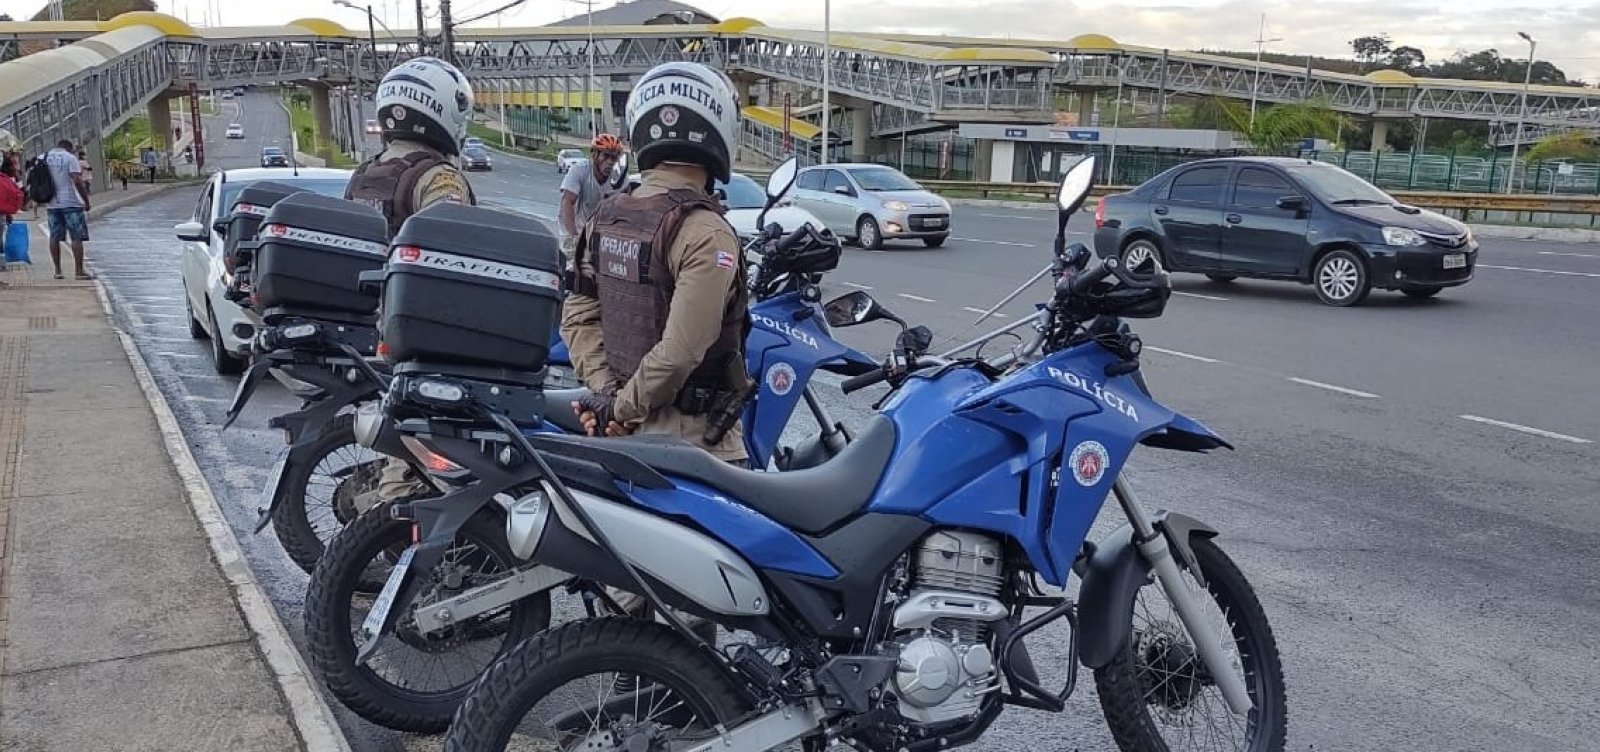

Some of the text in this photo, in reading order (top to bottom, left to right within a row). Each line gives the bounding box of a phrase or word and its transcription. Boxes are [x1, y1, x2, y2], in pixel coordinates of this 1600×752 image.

[399, 86, 443, 118] MILITAR
[670, 82, 723, 121] MILITAR
[751, 313, 818, 350] POLÍCIA
[1047, 366, 1139, 422] POLÍCIA
